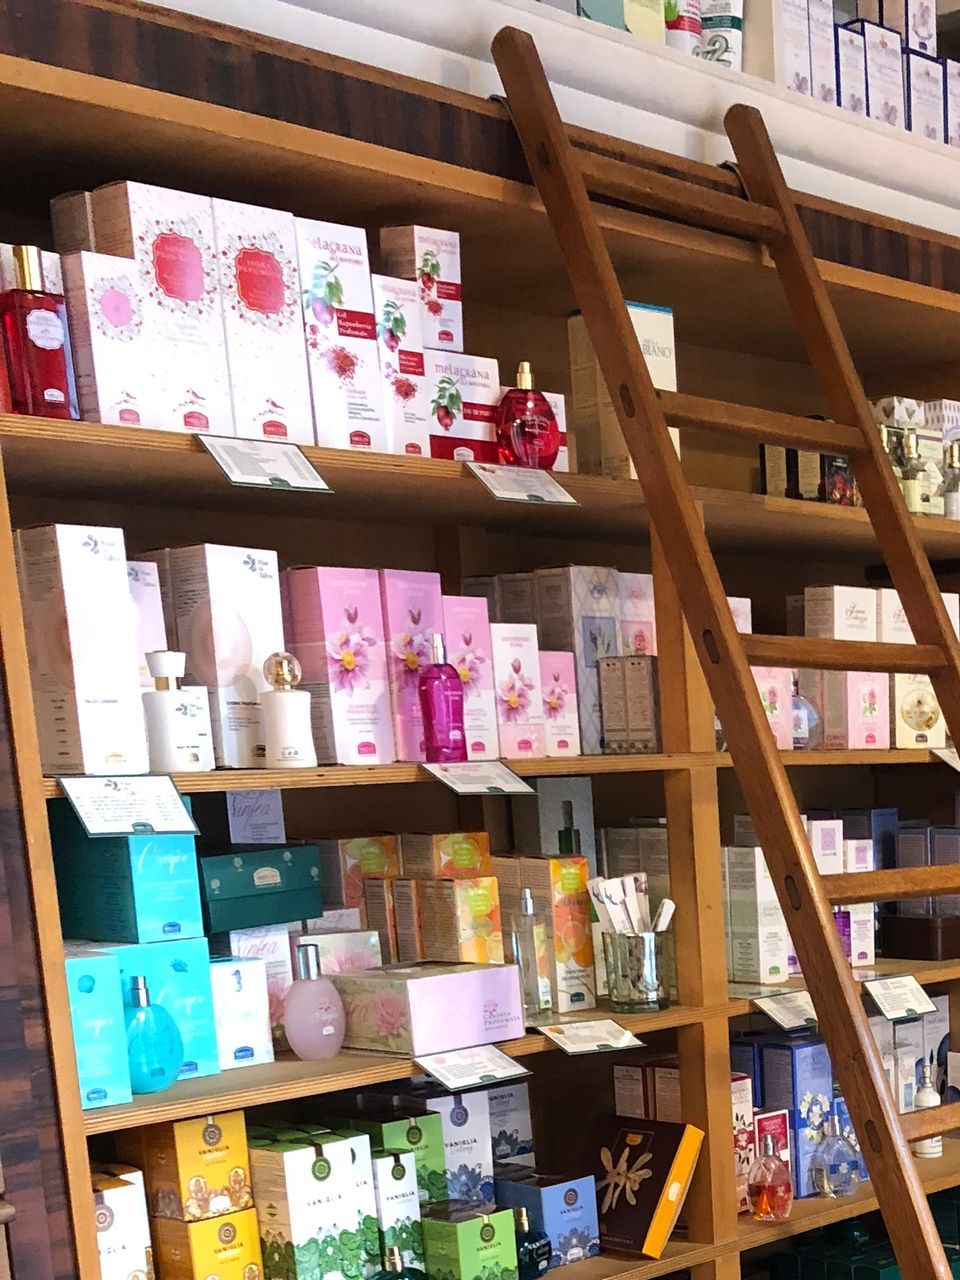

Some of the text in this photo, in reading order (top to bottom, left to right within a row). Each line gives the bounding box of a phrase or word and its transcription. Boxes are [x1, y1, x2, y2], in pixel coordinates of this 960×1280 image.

[444, 1137, 479, 1149] VANIGLIA
[198, 1145, 230, 1156] VANIGLIA
[386, 1190, 416, 1202] VANIGLIA
[559, 1205, 585, 1216] VANIGLIA
[213, 1242, 244, 1254] VANIGLIA
[475, 1241, 502, 1253] VANIGLIA
